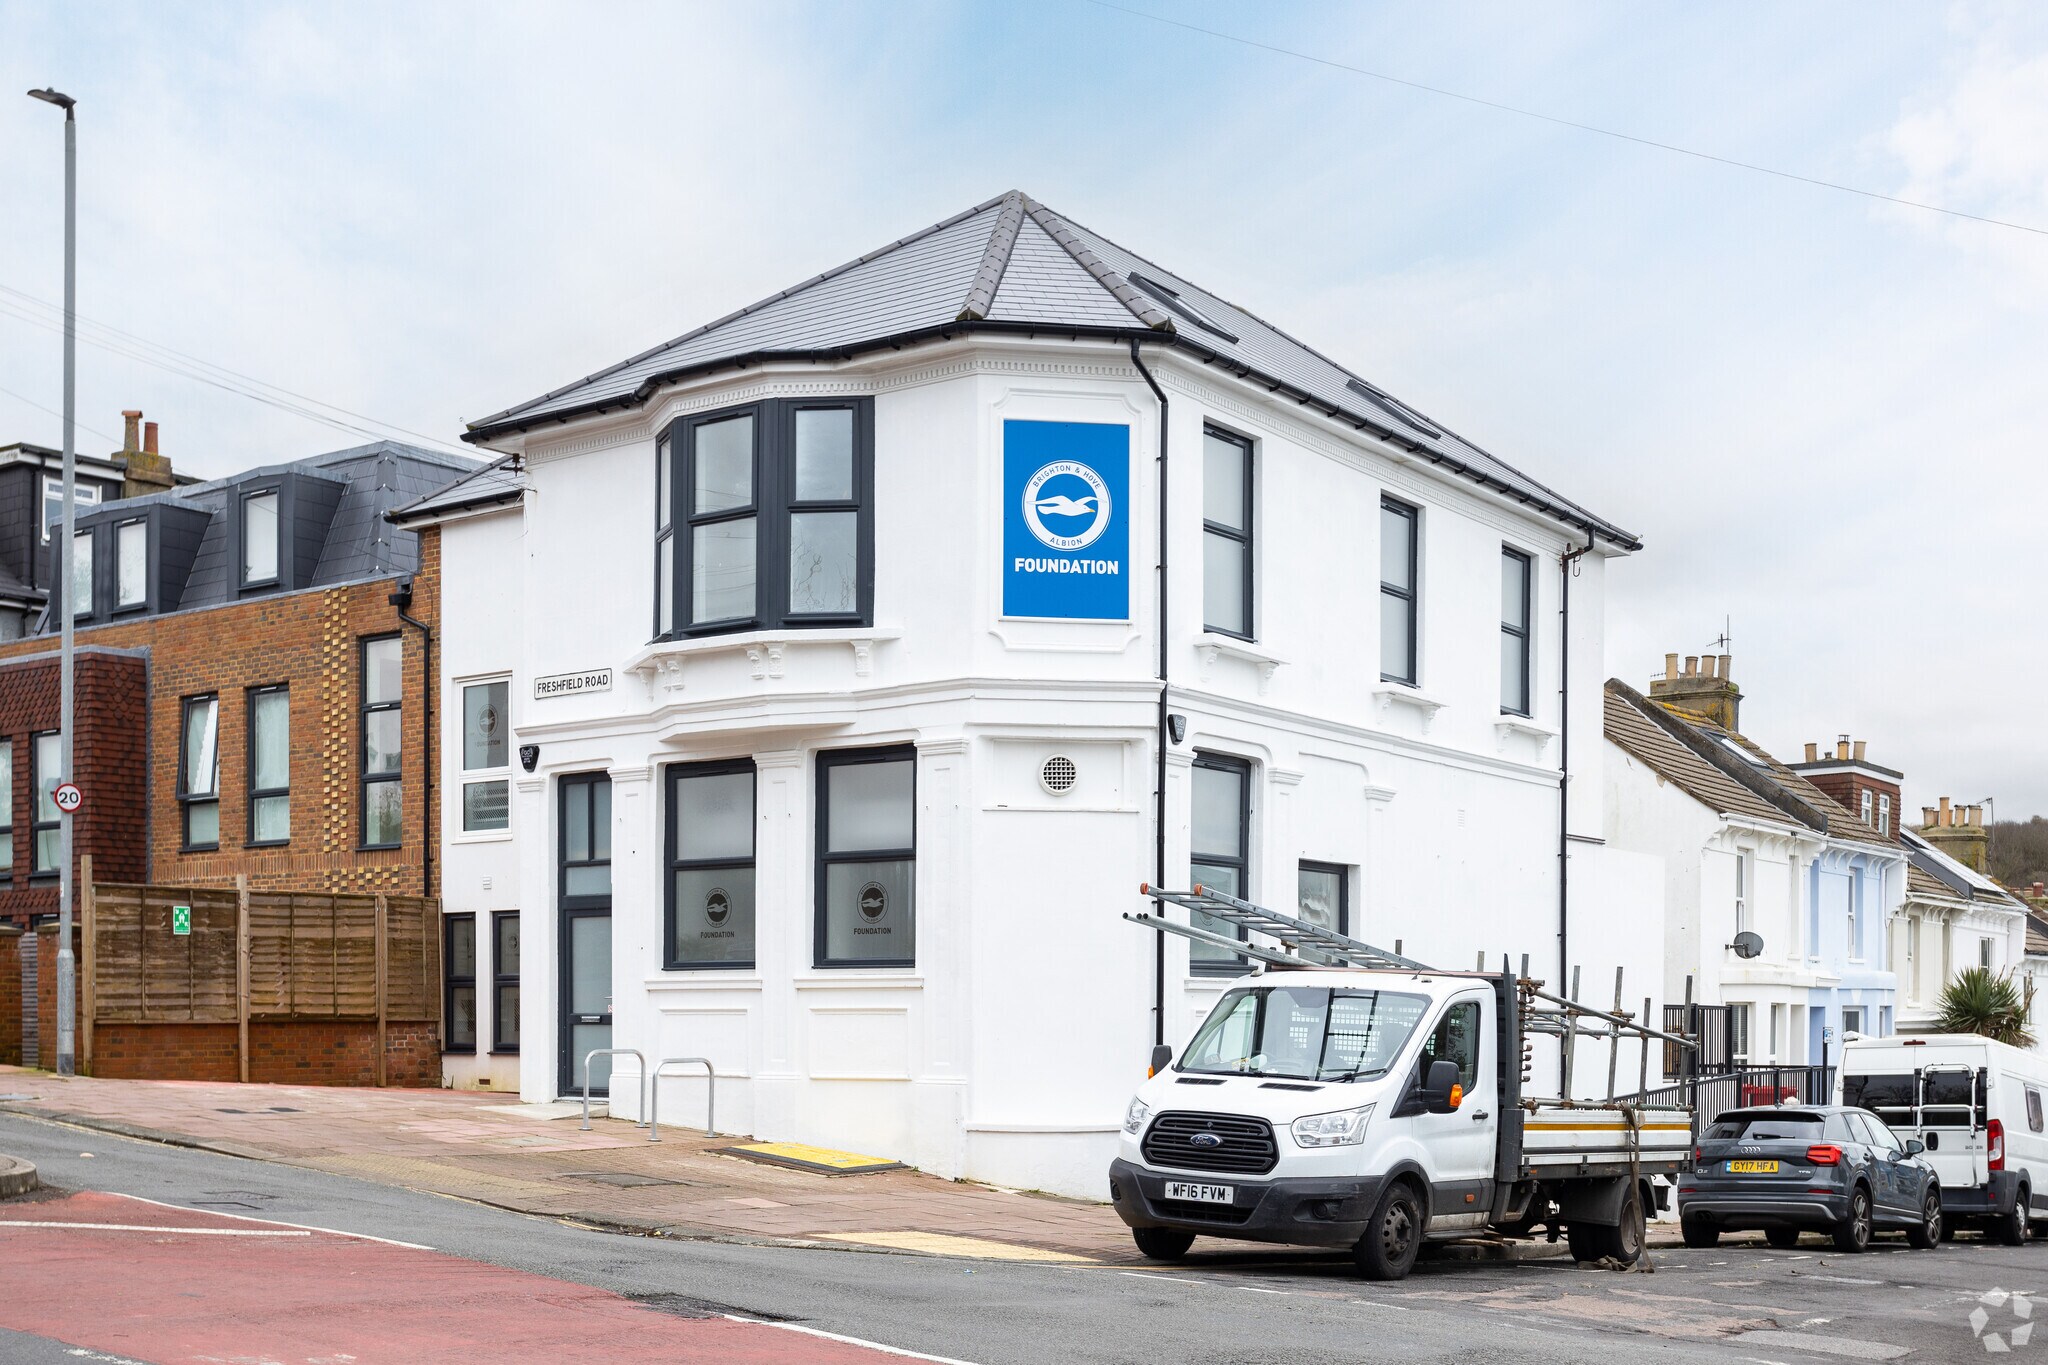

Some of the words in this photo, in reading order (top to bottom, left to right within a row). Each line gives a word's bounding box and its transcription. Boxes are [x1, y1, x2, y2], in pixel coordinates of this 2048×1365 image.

[1032, 465, 1071, 488] BRIGHTON
[1074, 466, 1080, 474] &
[1083, 470, 1101, 489] HOVE
[1049, 537, 1083, 547] ALBION
[1014, 557, 1119, 575] FOUNDATION
[537, 677, 583, 694] FRESHFIELD
[585, 674, 609, 688] ROAD
[59, 791, 79, 804] 20
[700, 931, 735, 939] FOUNDATION
[853, 927, 892, 935] FOUNDATION
[1733, 1161, 1754, 1171] GY17
[1756, 1161, 1775, 1171] HFA
[1172, 1183, 1198, 1198] WF16
[1201, 1185, 1226, 1201] FVM
